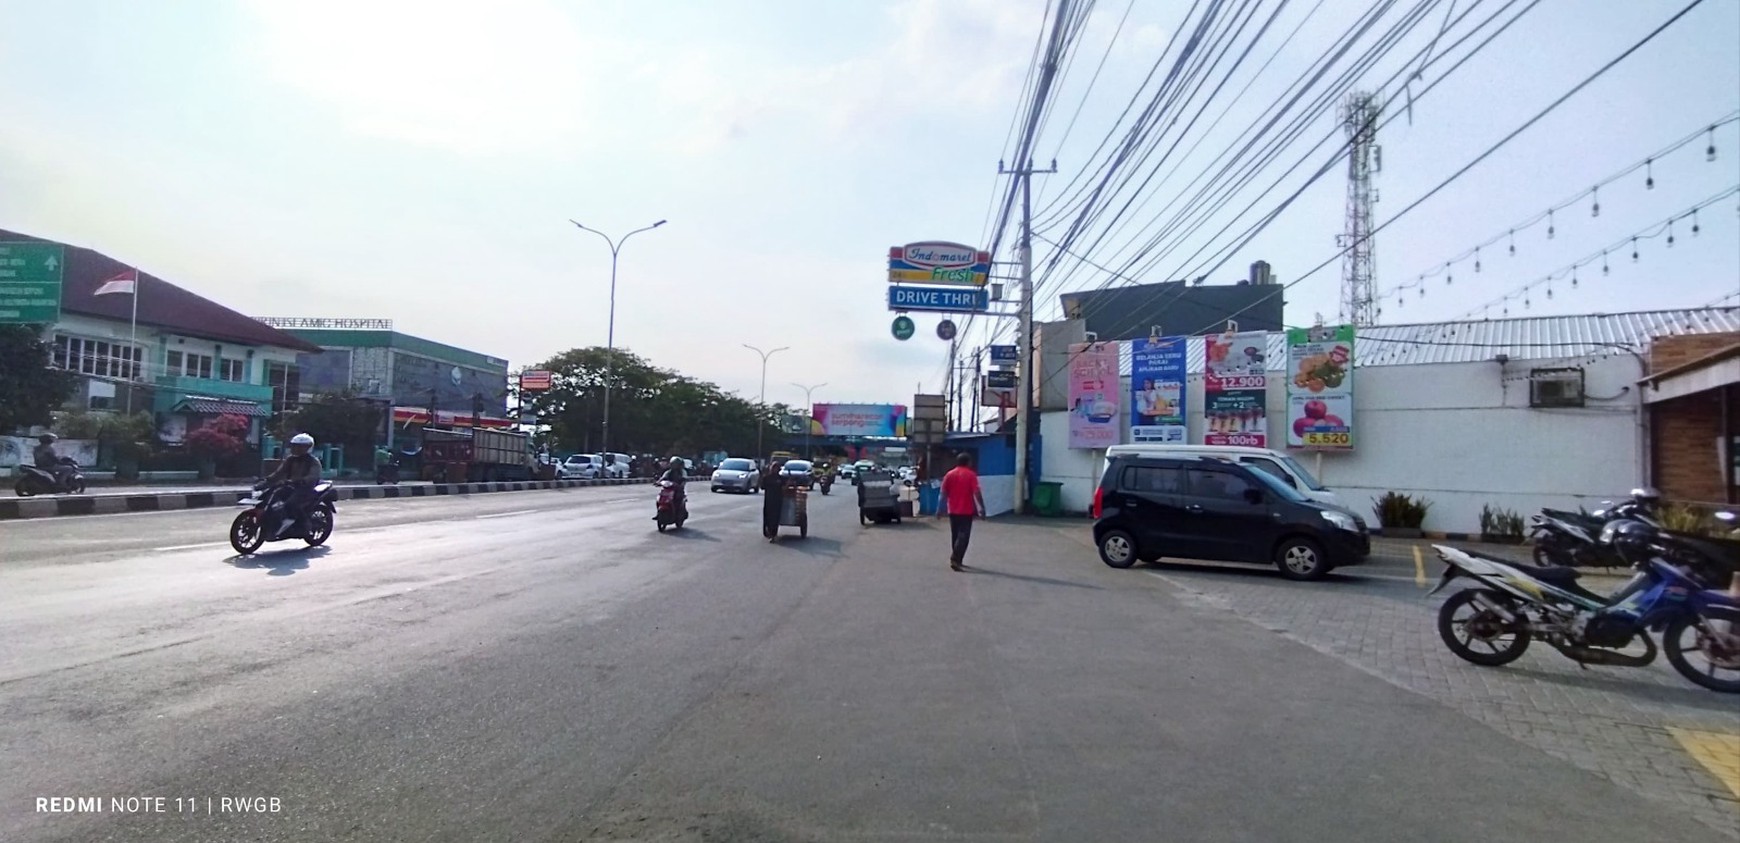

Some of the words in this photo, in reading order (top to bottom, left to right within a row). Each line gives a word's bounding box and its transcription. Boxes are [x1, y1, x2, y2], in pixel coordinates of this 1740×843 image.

[908, 248, 972, 262] Indomaret
[932, 266, 974, 282] Fresh
[896, 290, 939, 304] DRIVE
[283, 317, 331, 329] ISLAMIC
[334, 318, 391, 330] HOSPITAL
[1221, 377, 1264, 387] 12.900
[1228, 435, 1258, 445] 100rb
[1309, 433, 1349, 444] 5.520
